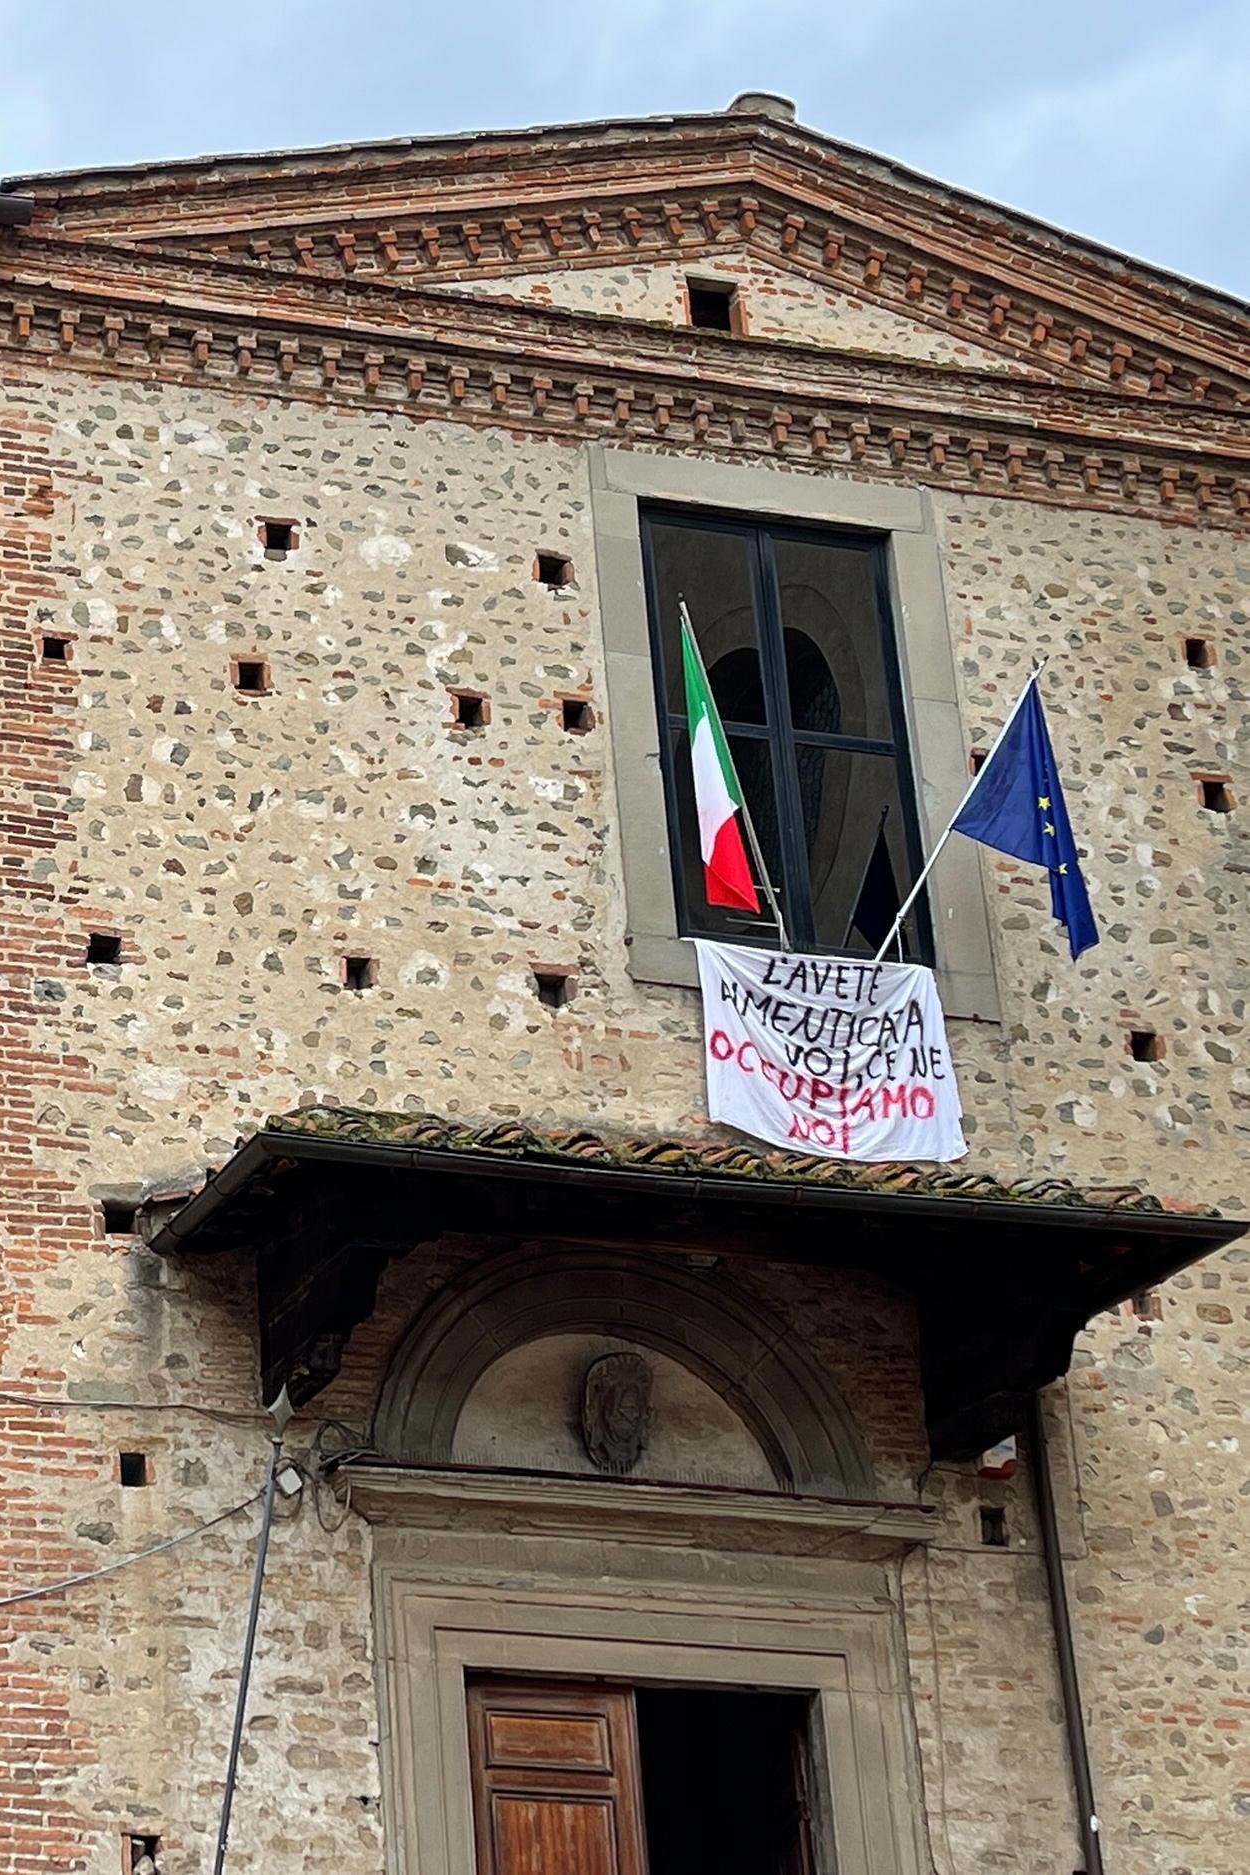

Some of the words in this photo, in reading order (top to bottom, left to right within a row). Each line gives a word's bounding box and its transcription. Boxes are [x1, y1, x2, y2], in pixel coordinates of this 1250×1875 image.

[762, 957, 883, 1006] L'AVETE
[710, 1029, 935, 1120] OCCUPIAMO
[866, 1049, 896, 1081] CE
[910, 1044, 945, 1080] NE
[788, 1112, 849, 1154] NOI
